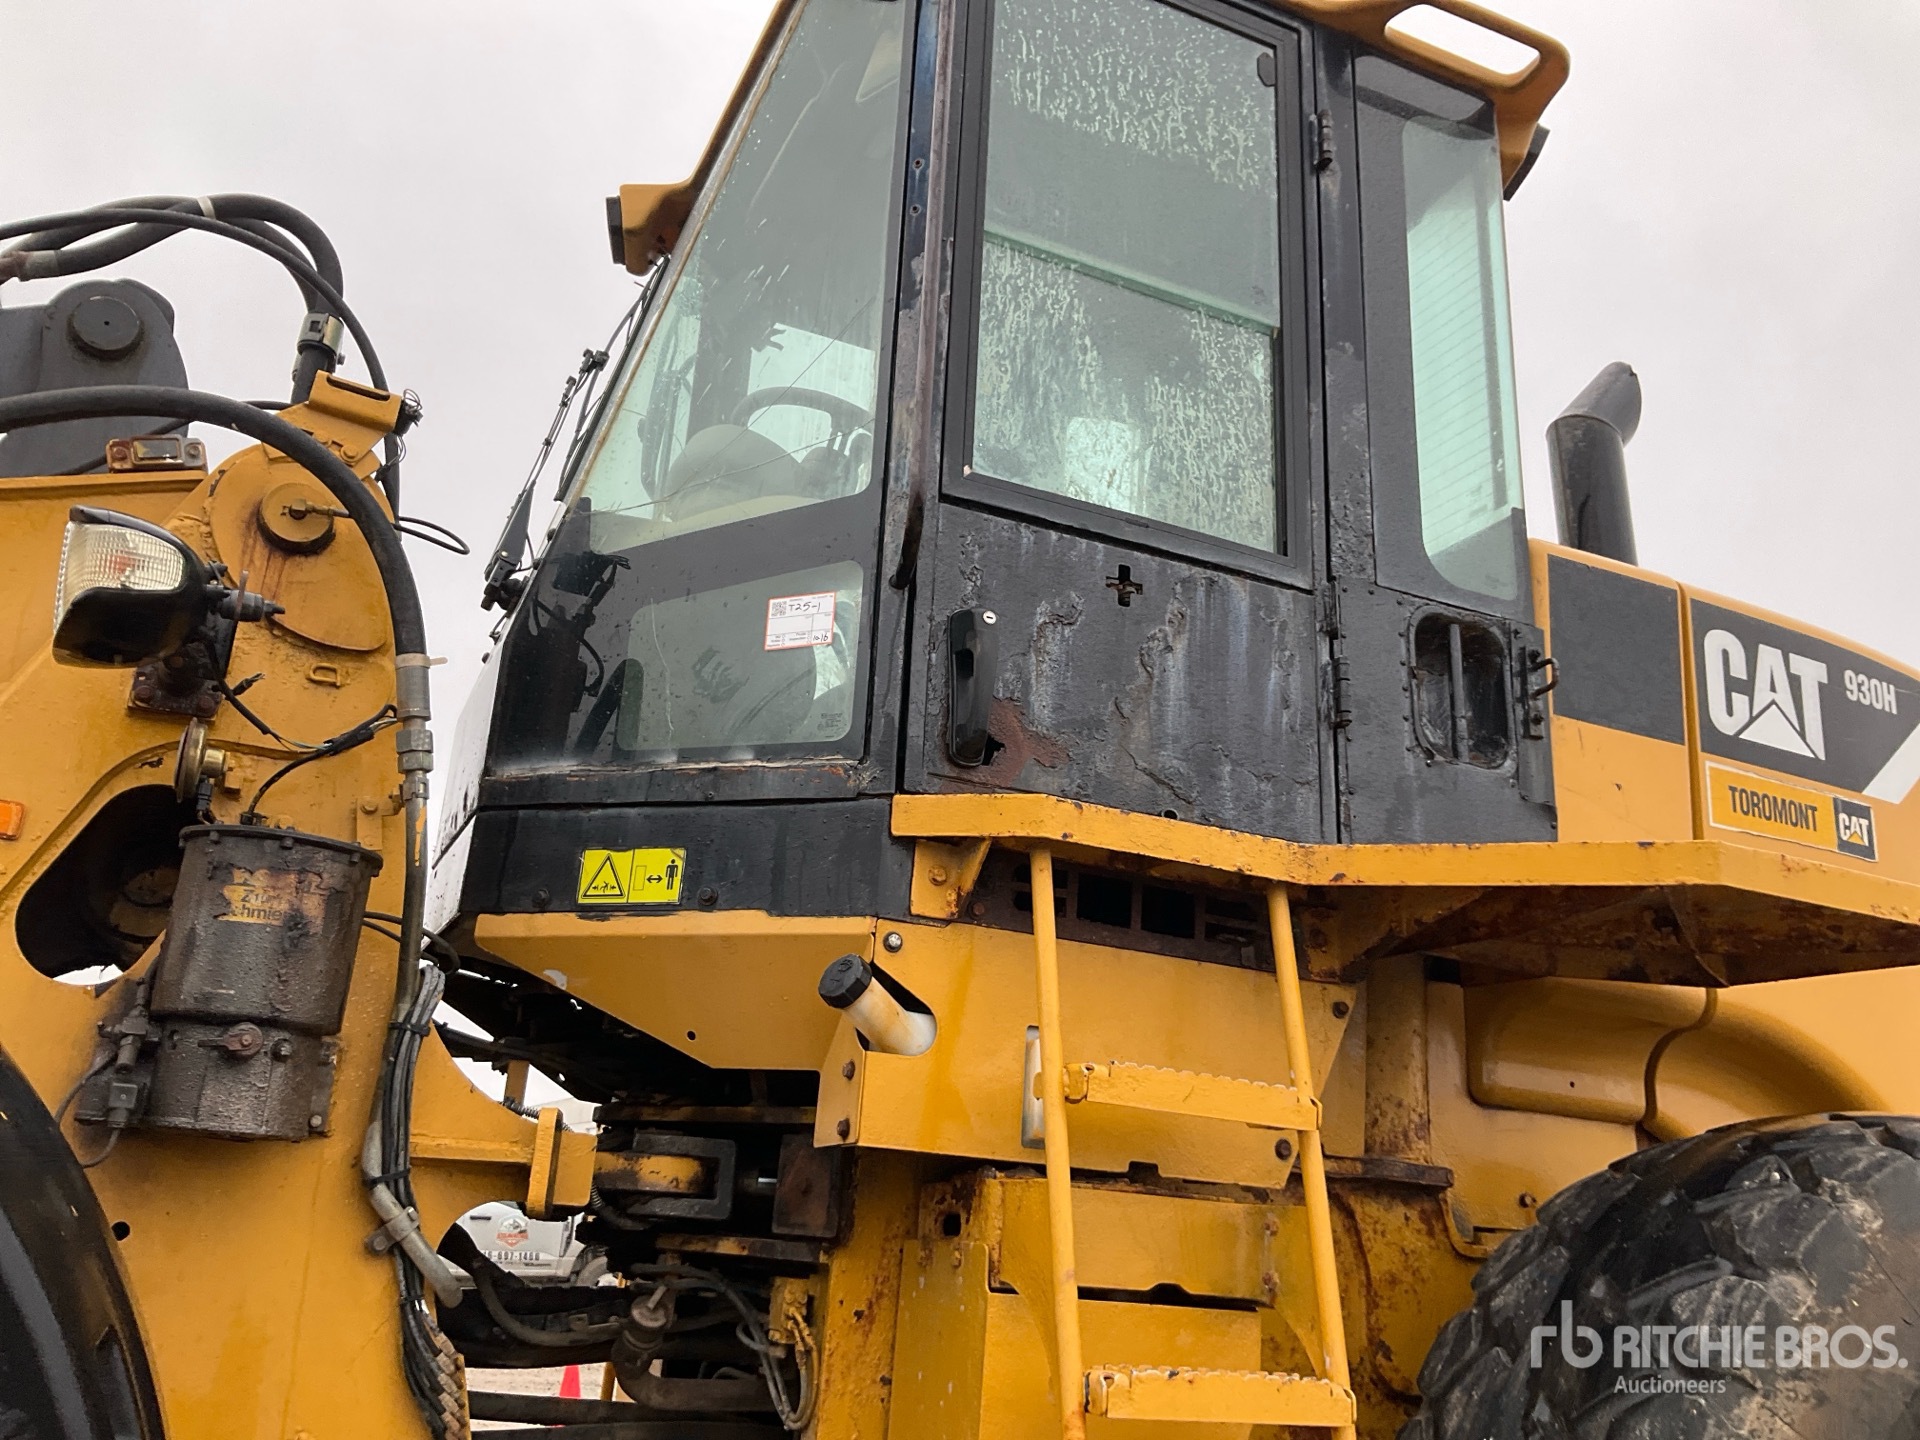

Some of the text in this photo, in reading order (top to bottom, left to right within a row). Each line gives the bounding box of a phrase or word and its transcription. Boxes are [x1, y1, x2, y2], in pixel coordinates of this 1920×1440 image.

[788, 601, 820, 613] T25-1
[1704, 629, 1828, 760] CAT
[1843, 669, 1897, 714] 930H
[1728, 785, 1818, 832] TOROMONT
[1838, 812, 1869, 847] CAT
